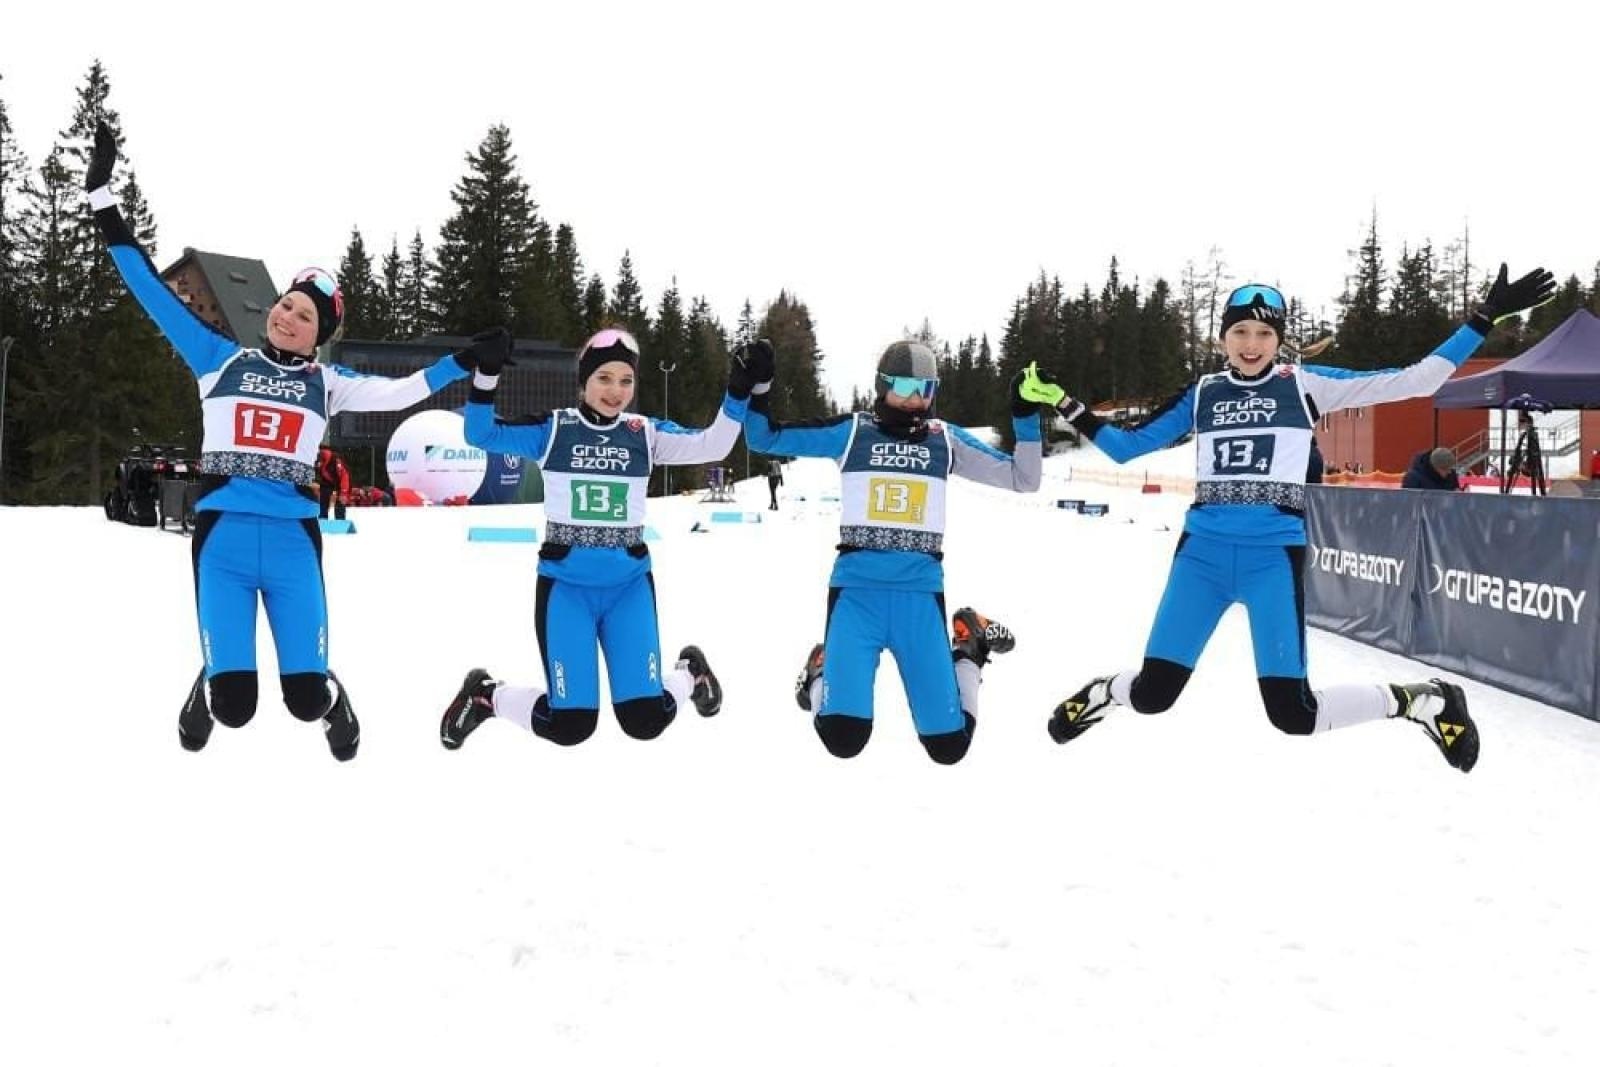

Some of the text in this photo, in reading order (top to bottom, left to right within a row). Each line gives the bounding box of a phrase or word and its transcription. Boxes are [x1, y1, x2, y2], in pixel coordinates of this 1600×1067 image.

[241, 408, 291, 449] 13 1
[1218, 439, 1268, 471] 13 4
[575, 484, 625, 518] 13 2
[874, 482, 910, 513] 13
